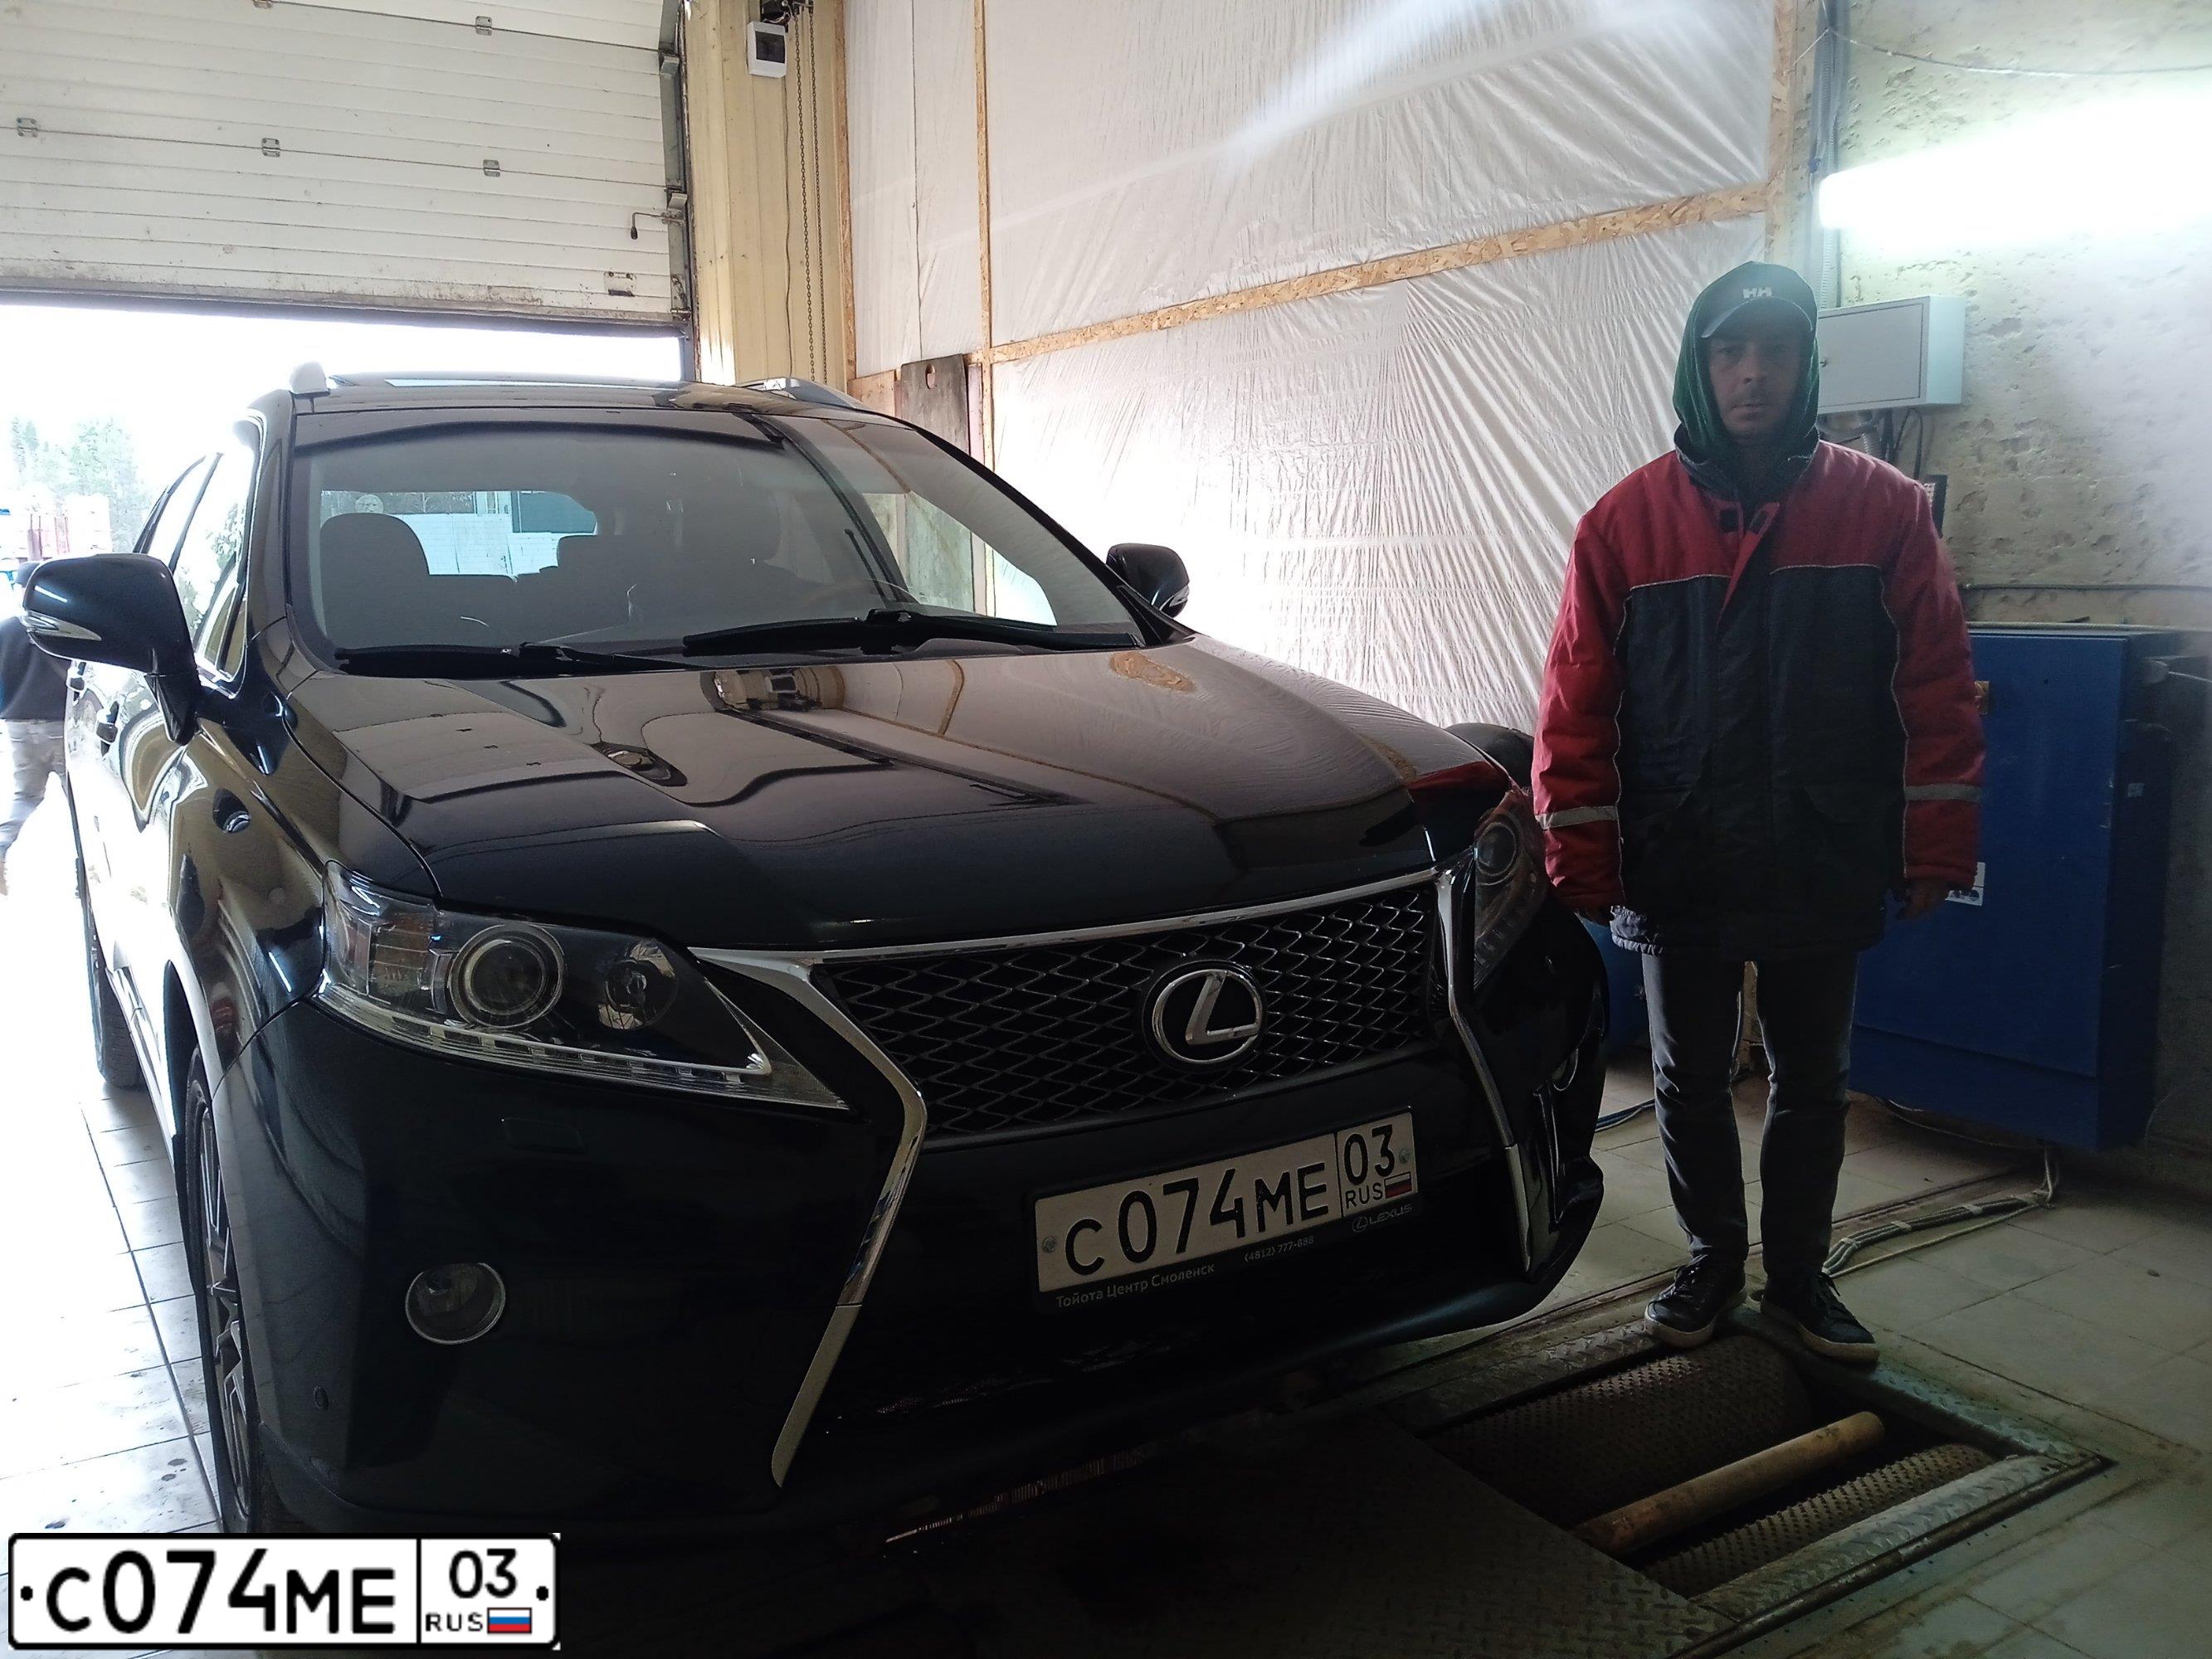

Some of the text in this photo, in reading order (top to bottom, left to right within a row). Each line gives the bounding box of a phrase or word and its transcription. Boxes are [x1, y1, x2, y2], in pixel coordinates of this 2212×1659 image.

[1343, 1123, 1396, 1185] 03
[1345, 1186, 1383, 1209] RUS
[1369, 1203, 1414, 1224] LEXUS
[1055, 1262, 1216, 1308] Тойота Центр Смоленск
